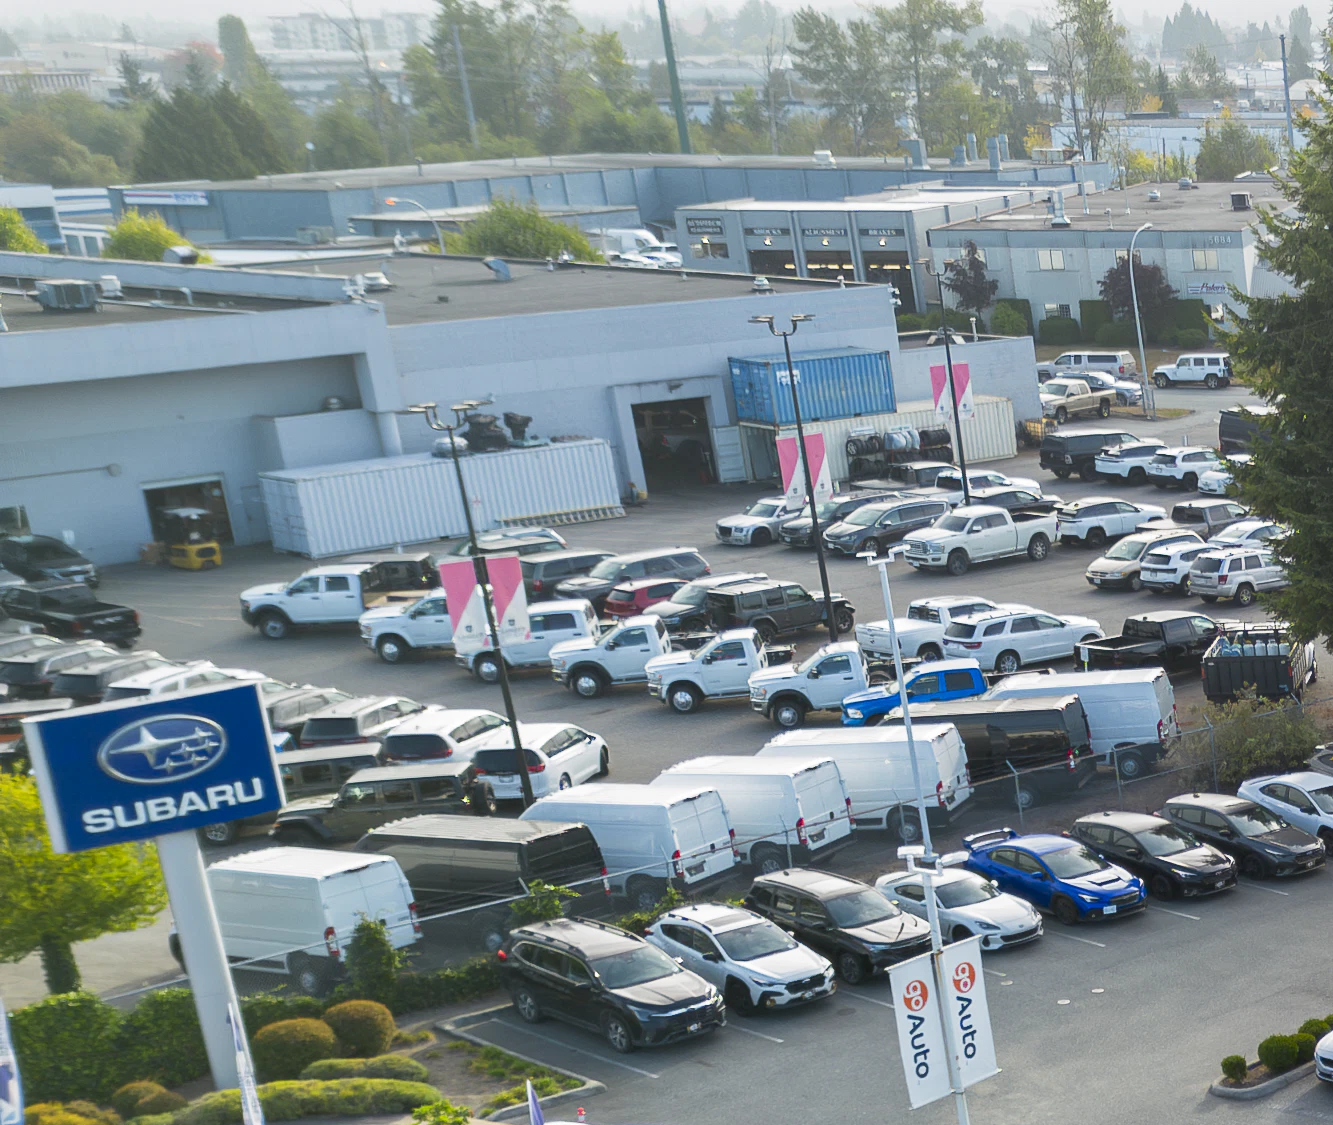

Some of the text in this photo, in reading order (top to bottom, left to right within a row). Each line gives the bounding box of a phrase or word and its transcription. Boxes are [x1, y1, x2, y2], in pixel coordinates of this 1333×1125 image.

[82, 777, 264, 834] SUBARU
[907, 1014, 930, 1079] Auto
[956, 995, 977, 1059] Auto
